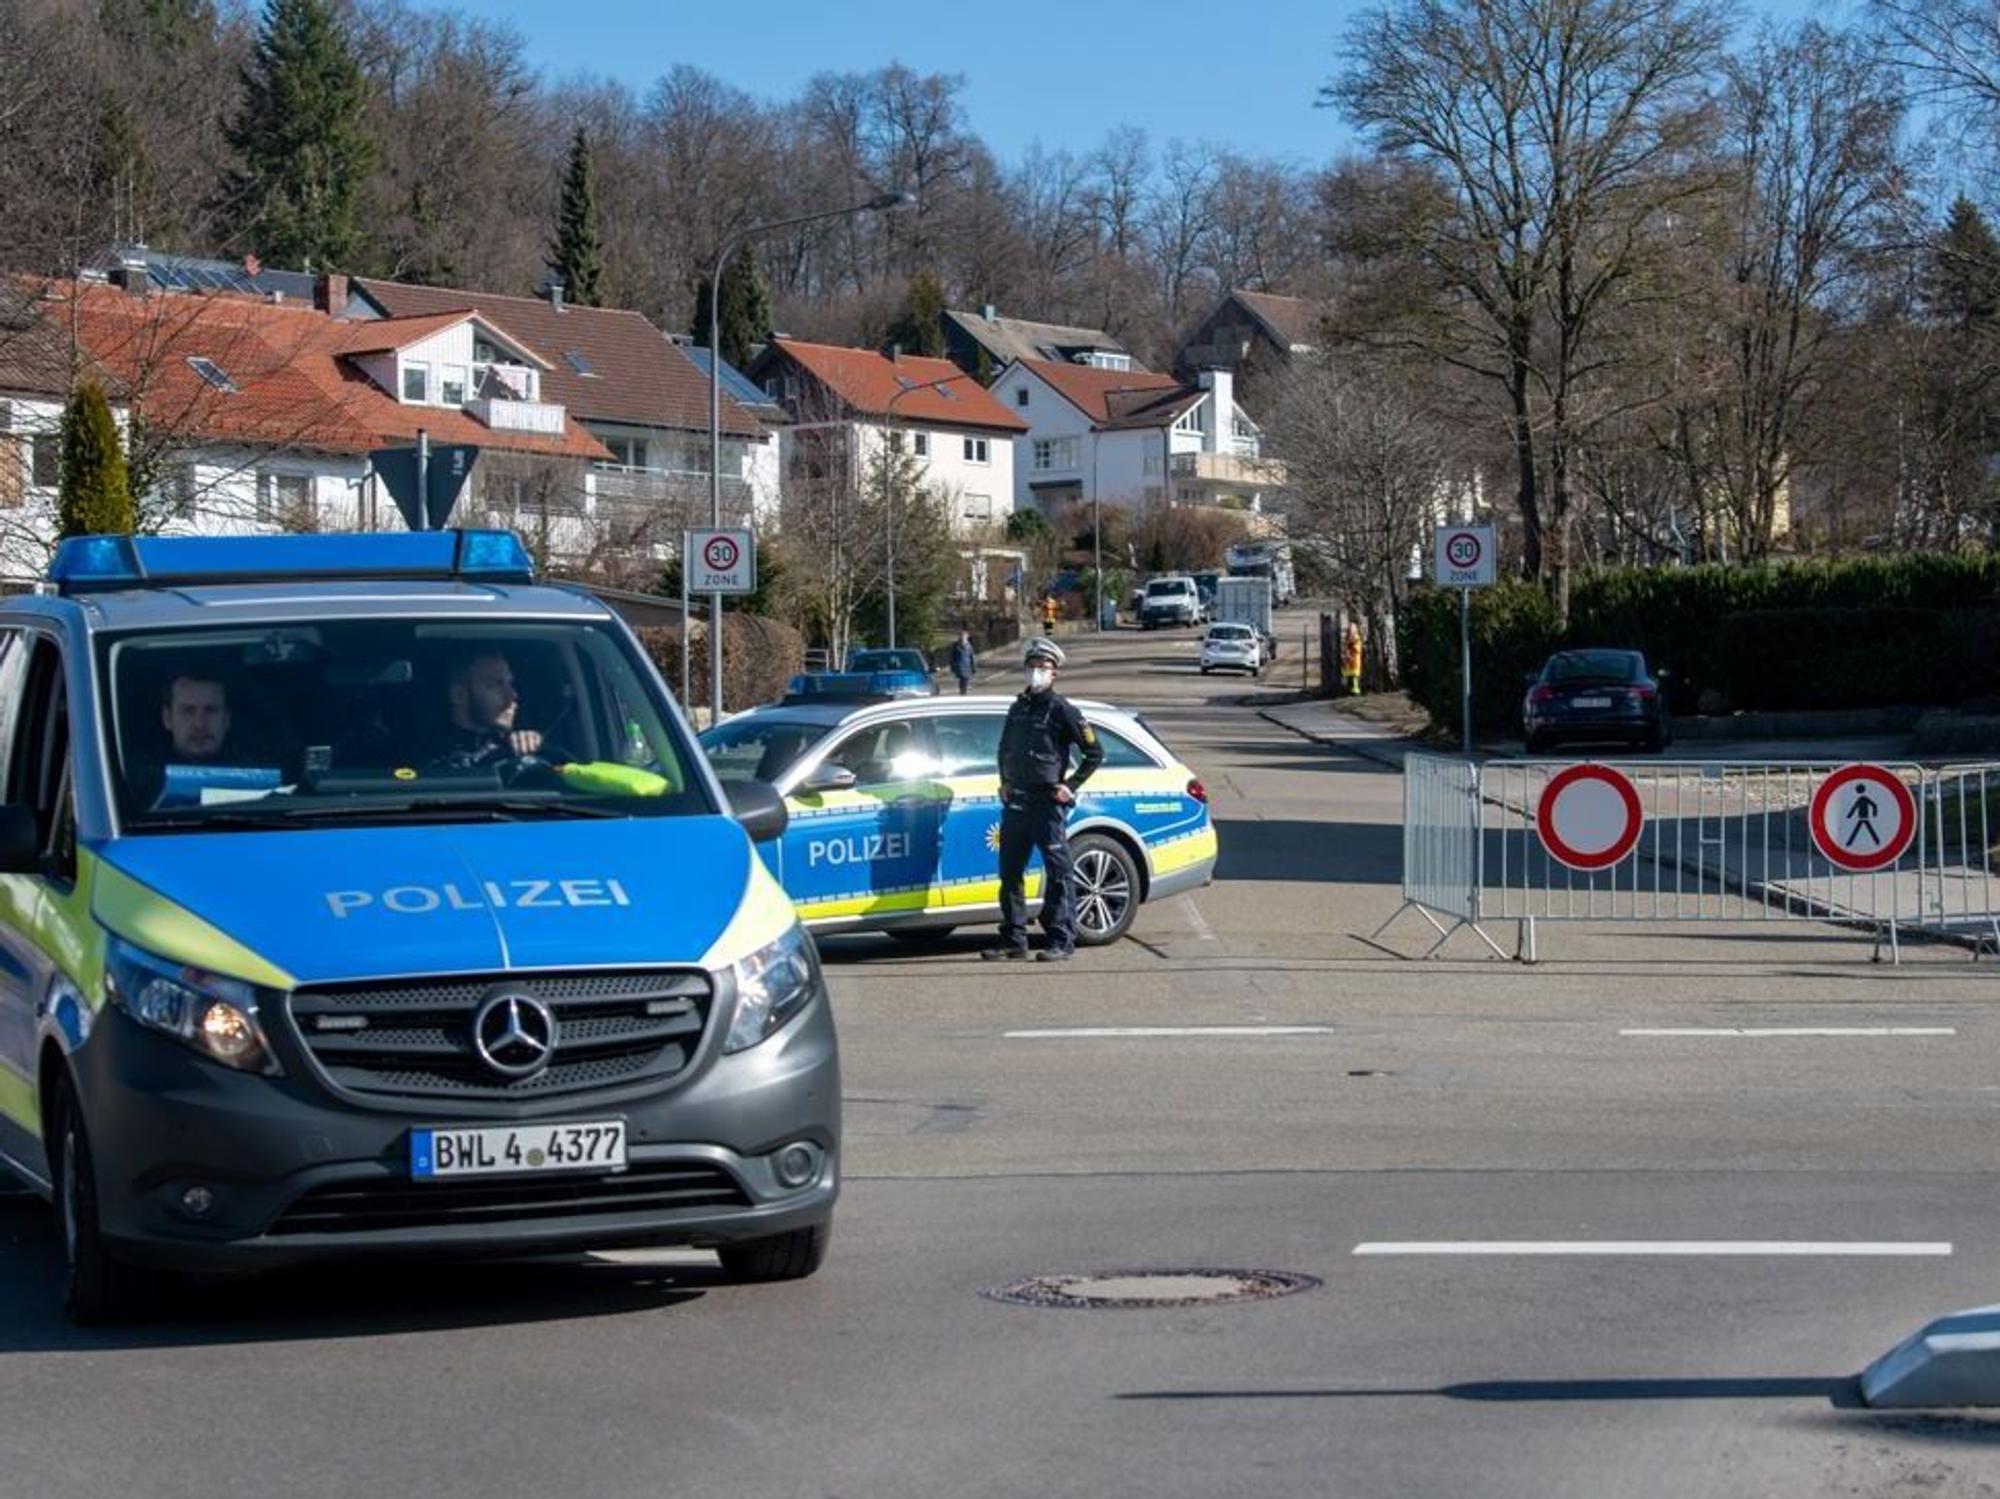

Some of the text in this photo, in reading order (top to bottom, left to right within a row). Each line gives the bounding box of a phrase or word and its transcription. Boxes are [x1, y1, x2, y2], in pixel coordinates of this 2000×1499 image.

[711, 545, 732, 562] 30
[1454, 541, 1474, 559] 30
[704, 574, 738, 586] ZONE
[808, 832, 910, 867] POLIZEI
[325, 878, 631, 918] POLIZEI
[435, 1127, 621, 1169] BWL 4 4377
